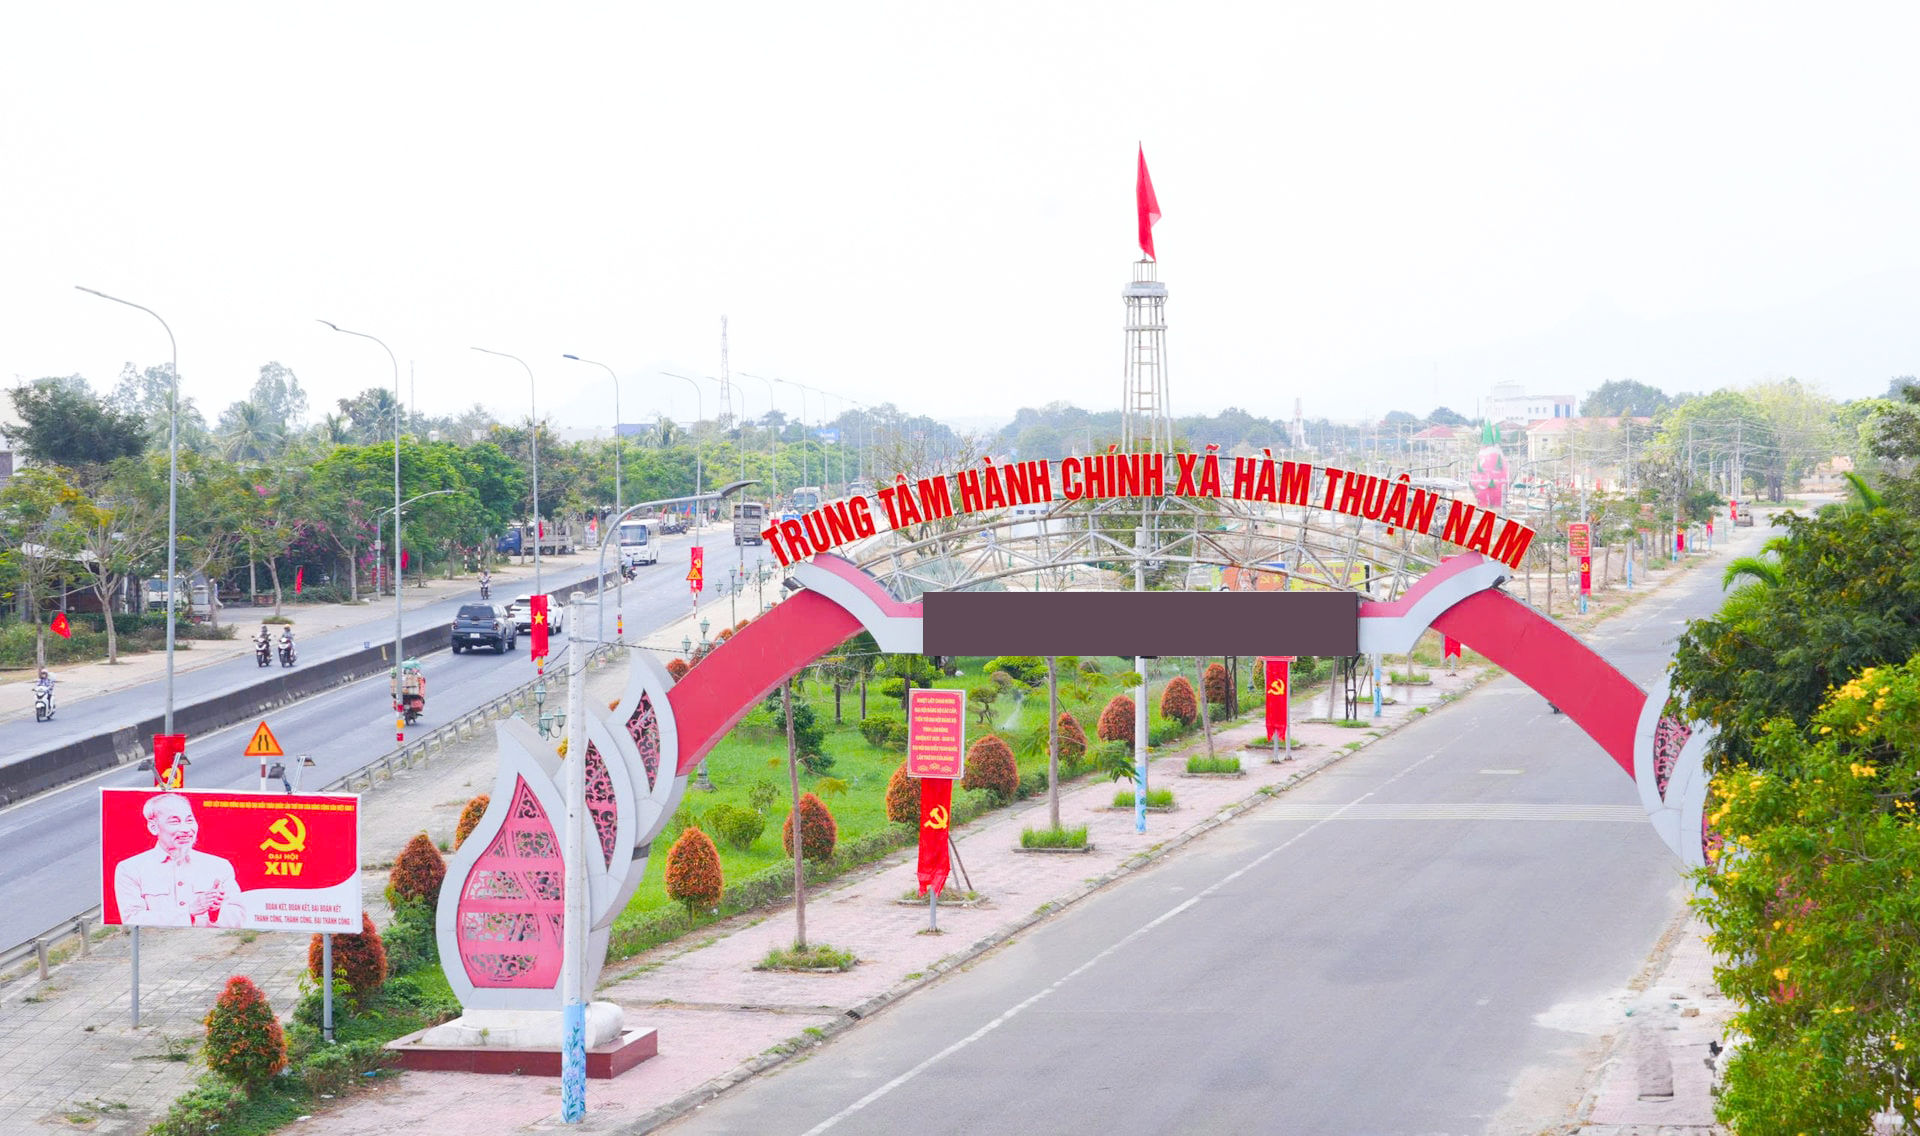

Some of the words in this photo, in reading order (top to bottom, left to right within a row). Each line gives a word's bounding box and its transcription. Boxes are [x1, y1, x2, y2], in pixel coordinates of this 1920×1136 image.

[761, 494, 877, 568] TRUNG
[877, 473, 954, 531] TÂM
[957, 456, 1052, 513] HÀNH
[1061, 444, 1163, 501] CHÍNH
[1175, 443, 1222, 498] XÃ
[1233, 448, 1312, 506] HÀM
[1323, 467, 1439, 535] THUẬN
[1441, 500, 1536, 569] NAM
[264, 861, 304, 876] XIV
